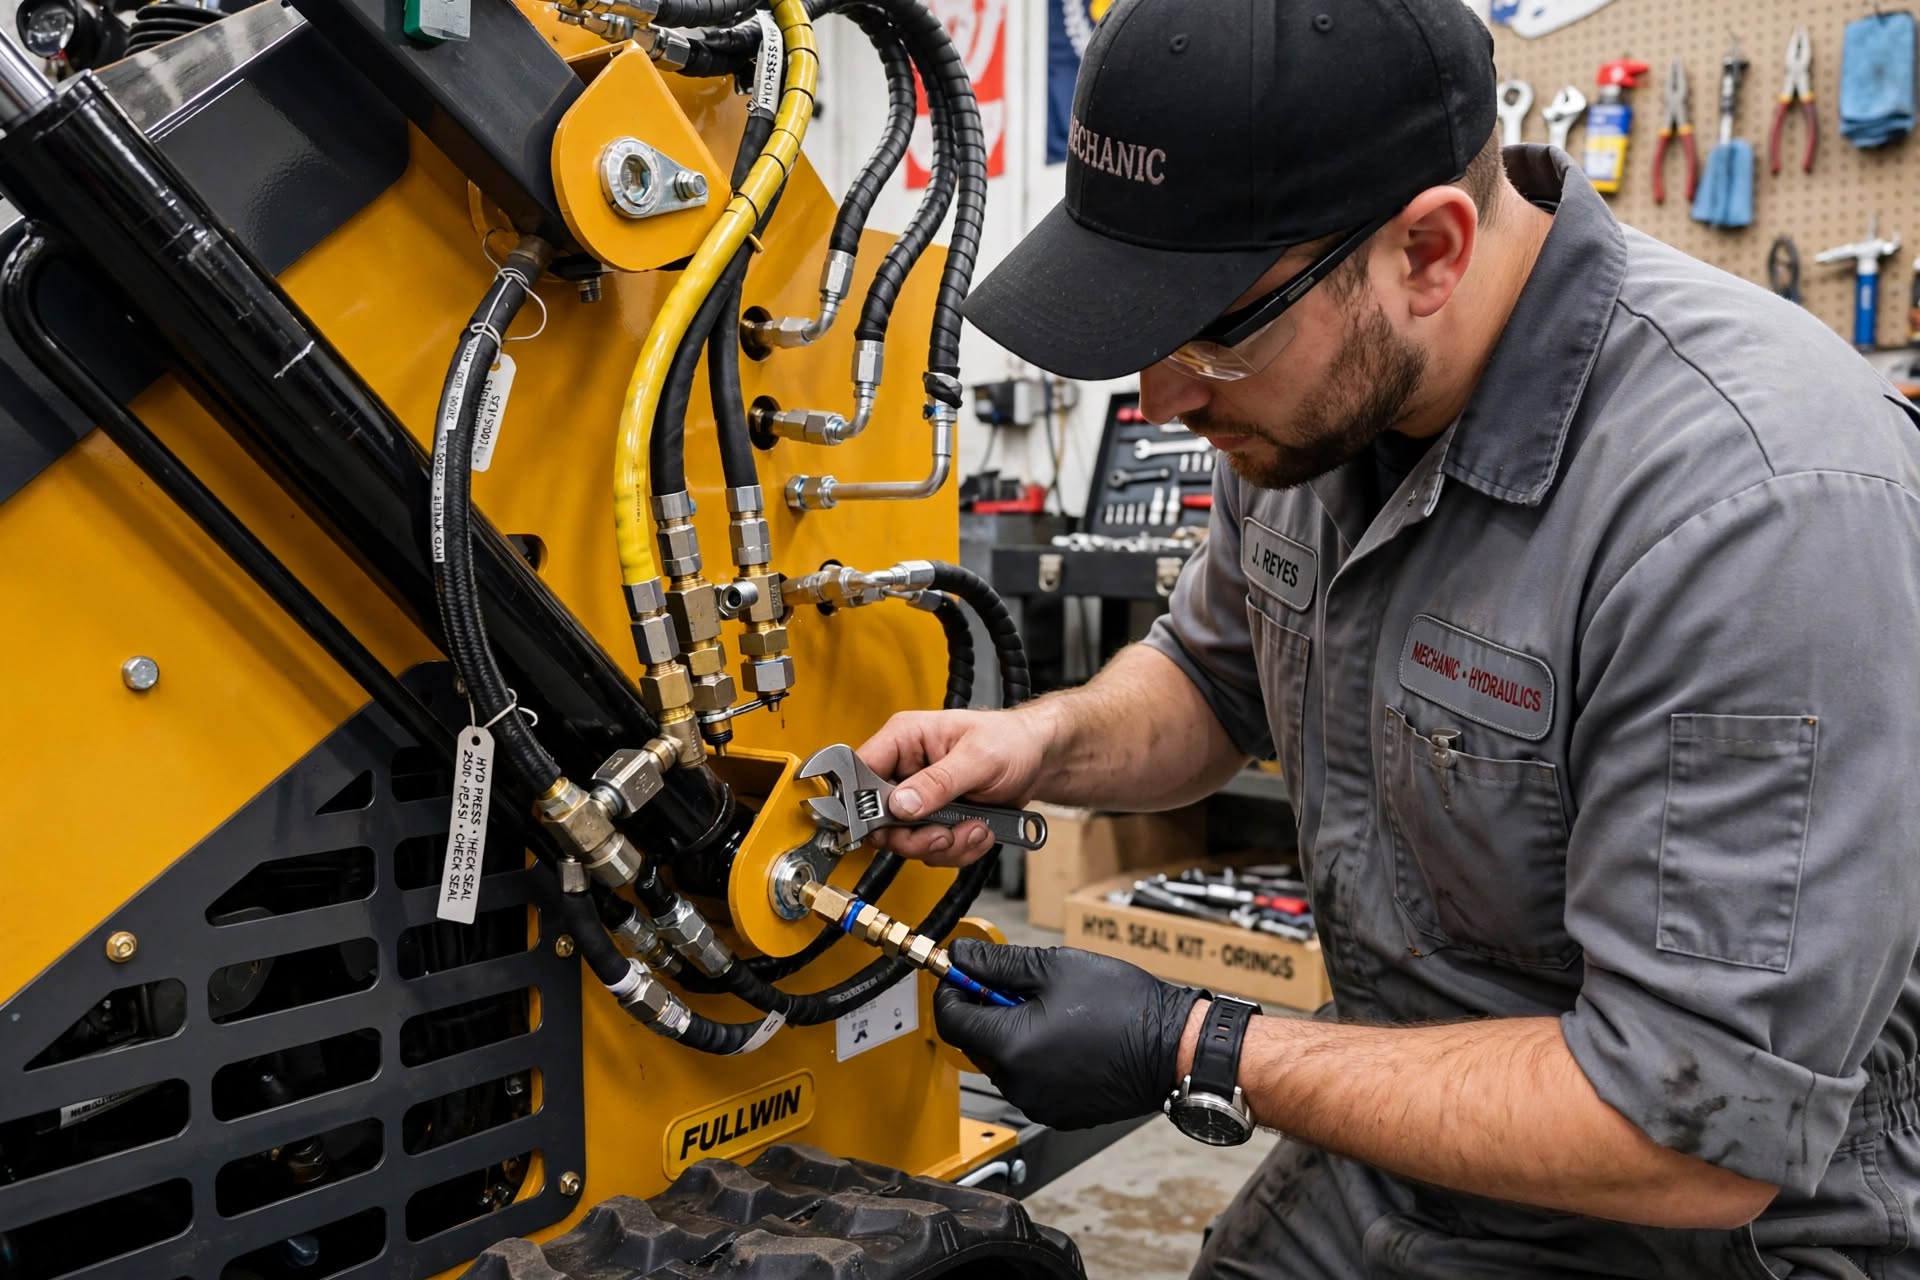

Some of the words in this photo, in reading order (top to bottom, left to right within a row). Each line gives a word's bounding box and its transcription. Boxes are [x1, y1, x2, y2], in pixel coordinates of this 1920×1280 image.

[1252, 542, 1260, 567] J.
[1262, 548, 1299, 588] REYES
[1411, 640, 1461, 681] MECHANIC
[1468, 667, 1542, 713] HYDRAULICS
[475, 756, 488, 784] HYD
[471, 787, 484, 826] PRESS
[450, 832, 465, 872] CHECK
[446, 873, 461, 903] SEAL
[460, 873, 475, 901] SEAL
[1128, 923, 1169, 954] SEAL
[1175, 935, 1206, 960] KIT
[1220, 943, 1295, 981] ORINGS
[680, 1084, 802, 1161] FULLWIN
